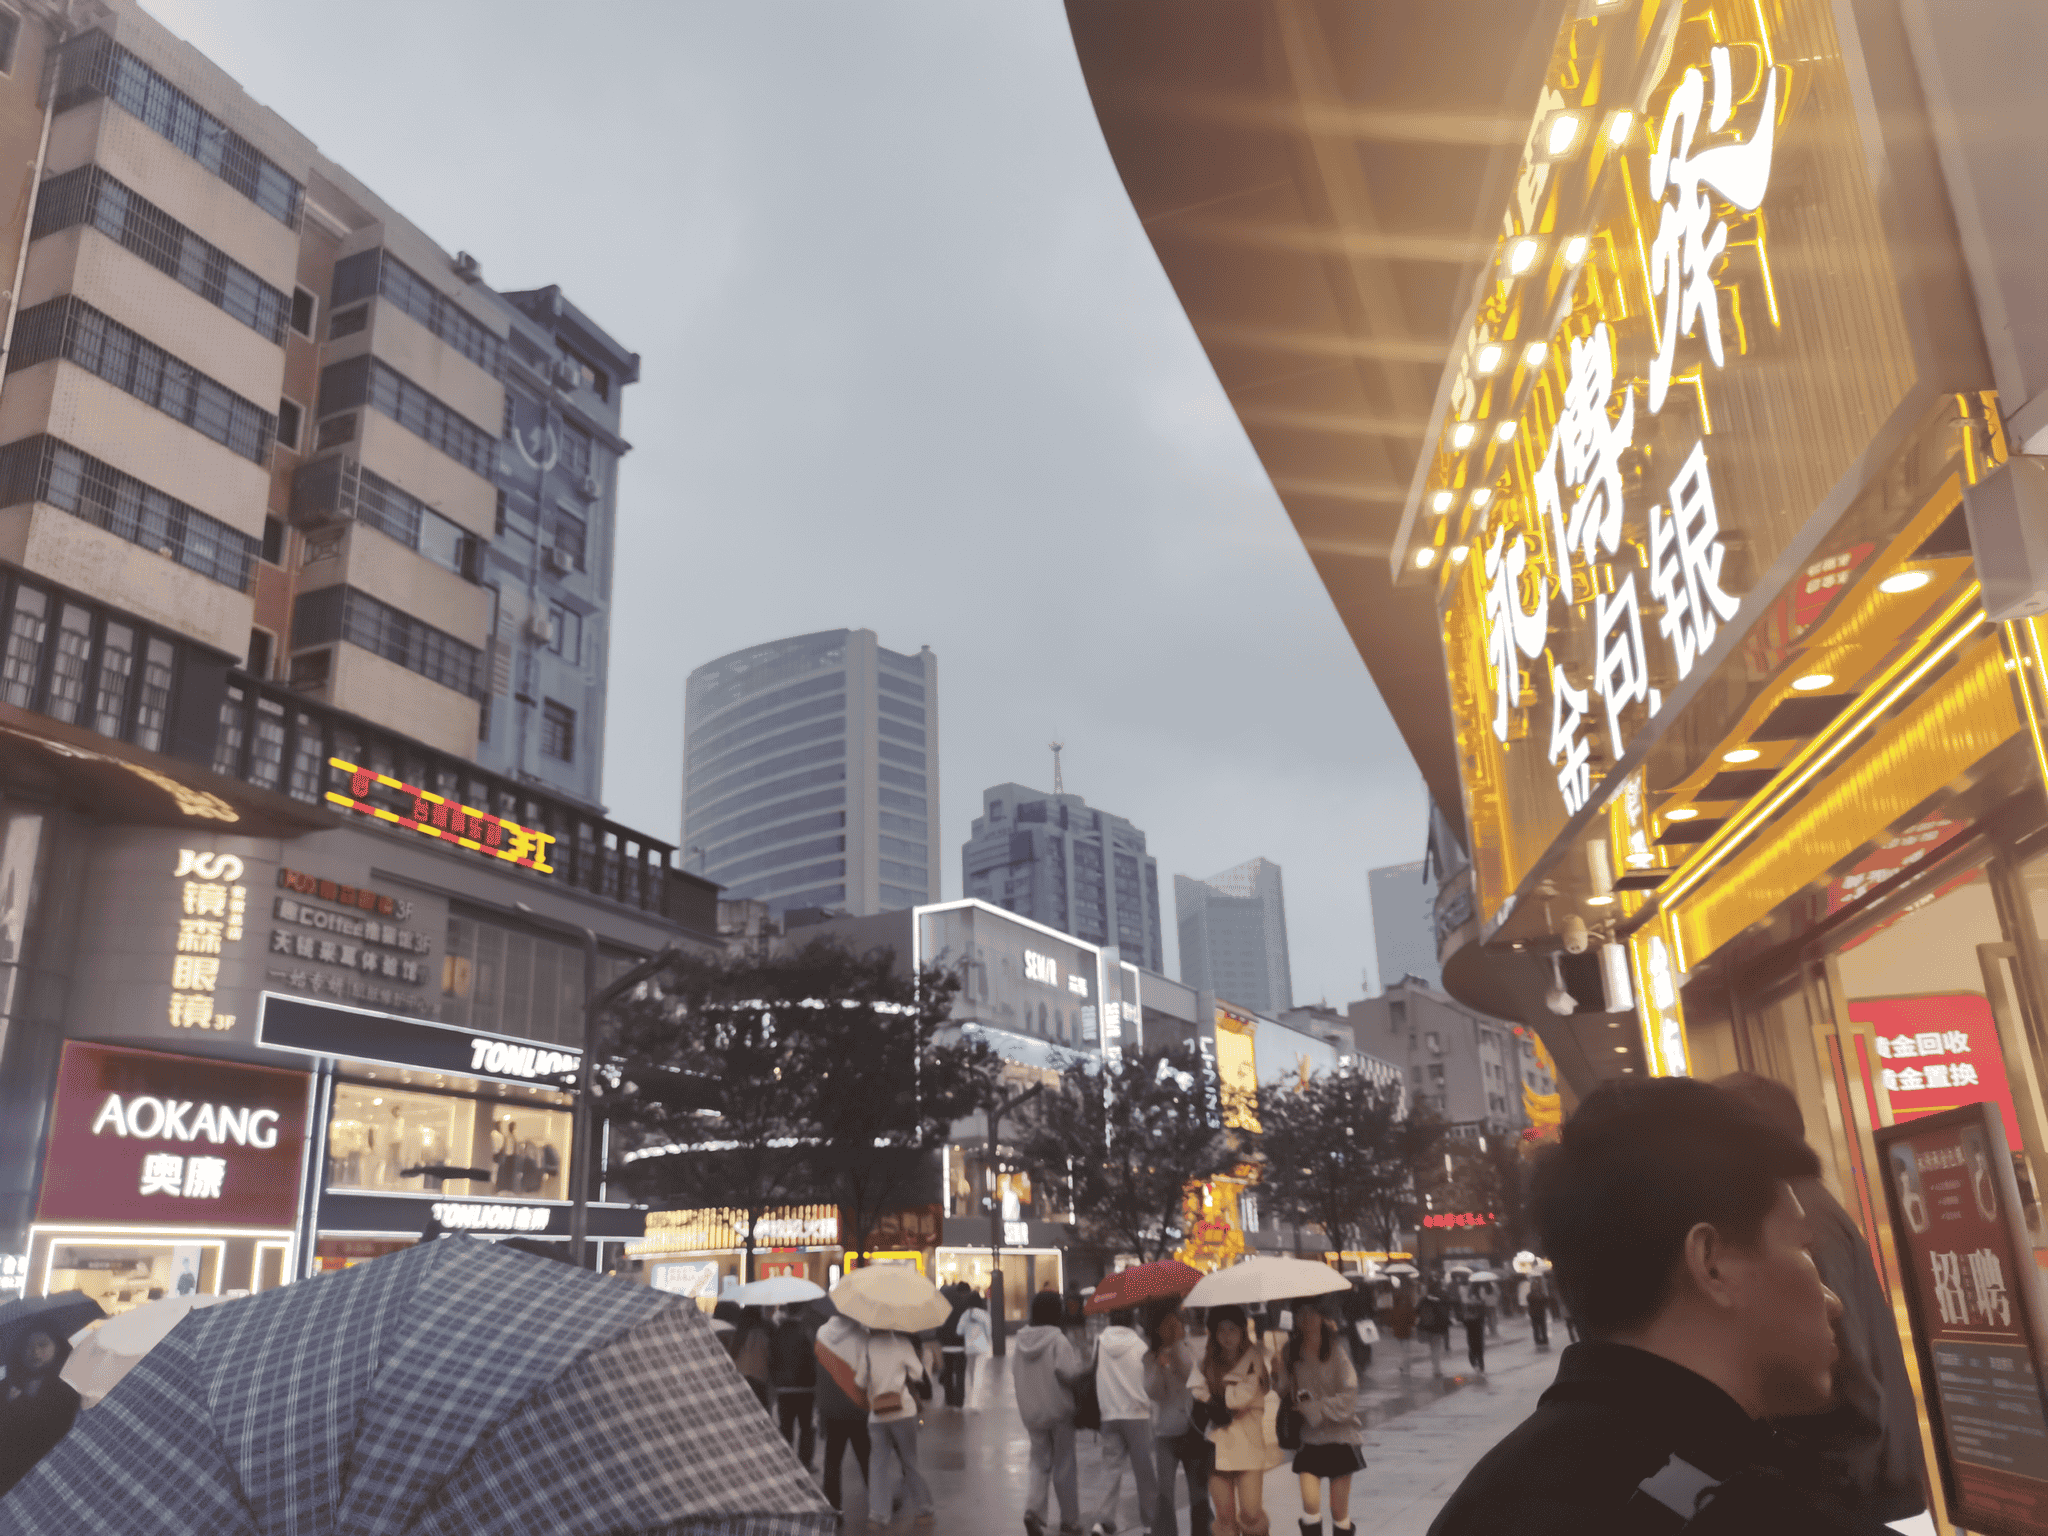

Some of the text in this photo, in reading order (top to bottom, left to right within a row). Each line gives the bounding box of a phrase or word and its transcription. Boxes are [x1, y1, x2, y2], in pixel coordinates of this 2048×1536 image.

[91, 1093, 280, 1149] AOKANG
[139, 1153, 227, 1199] 奥康
[1929, 1248, 2011, 1327] 招聘
